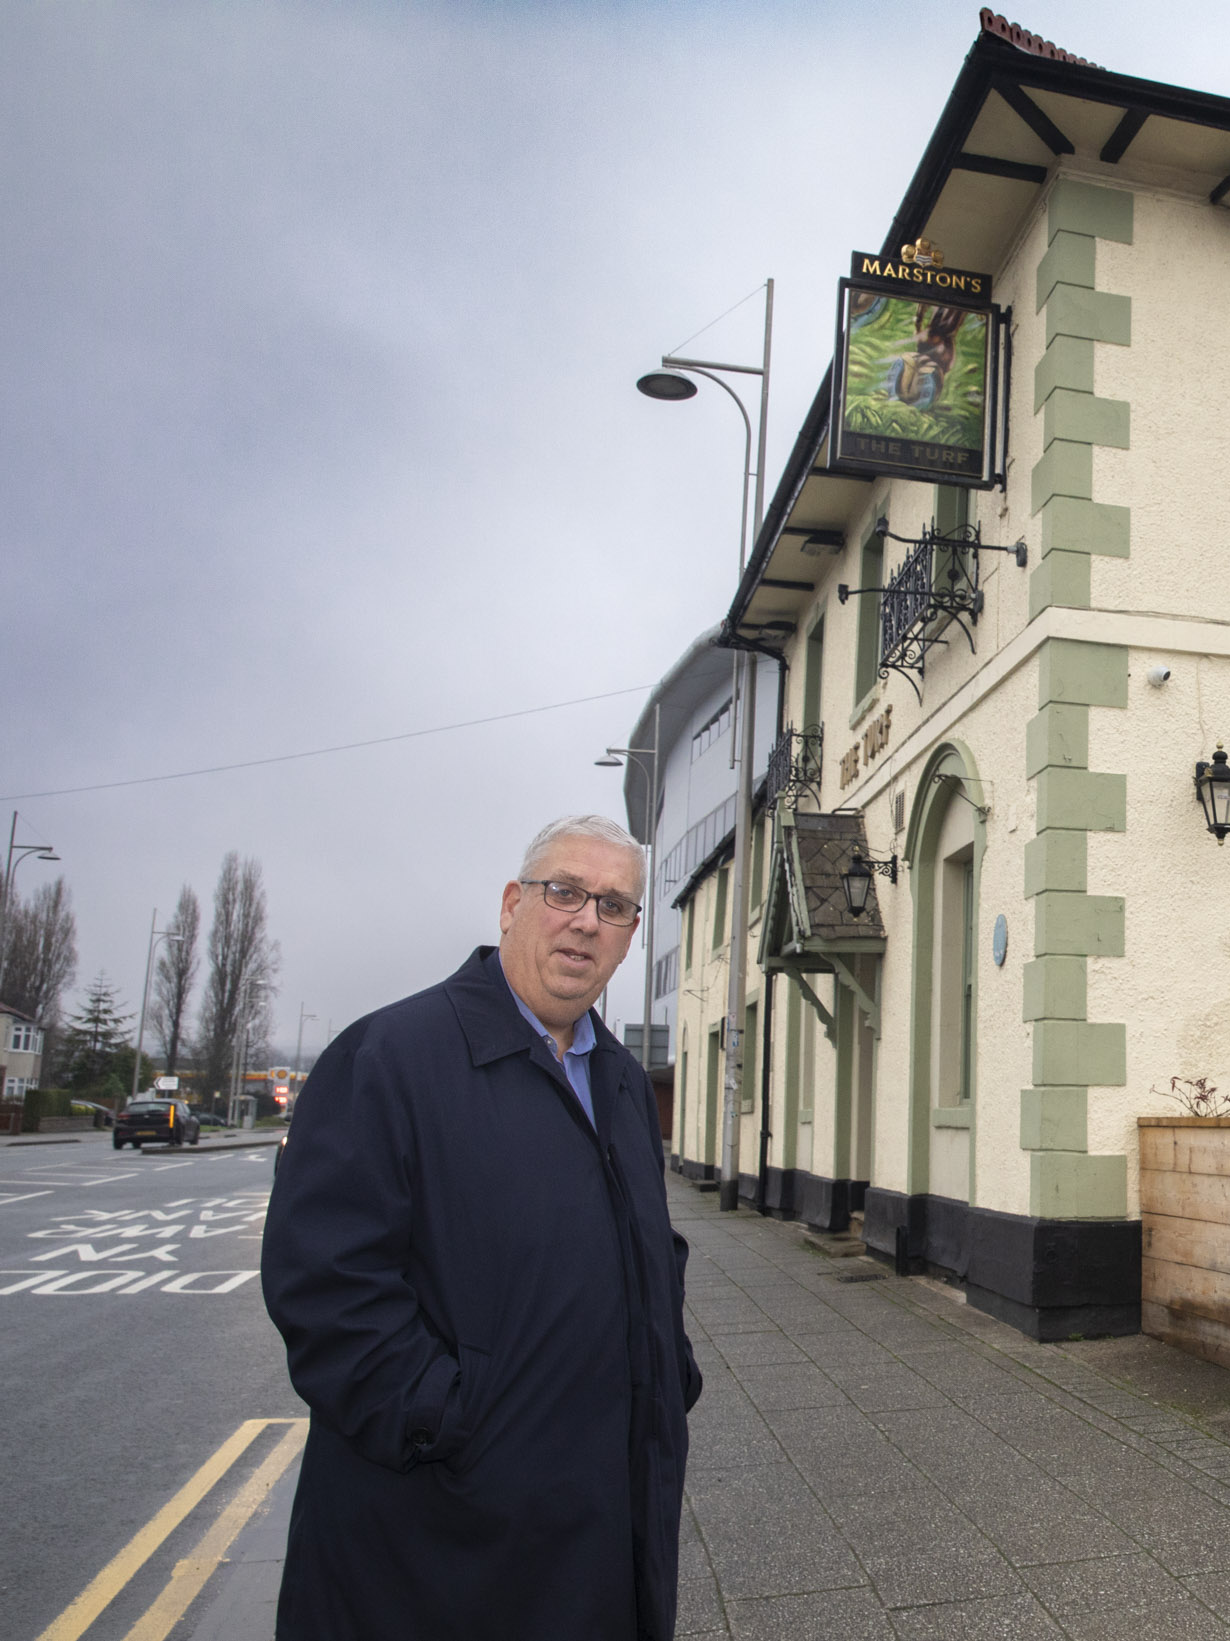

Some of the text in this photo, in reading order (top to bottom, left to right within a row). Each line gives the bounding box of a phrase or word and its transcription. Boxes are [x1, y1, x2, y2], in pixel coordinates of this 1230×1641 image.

[862, 258, 982, 293] MARSTON'S
[857, 438, 971, 464] THE TURF
[839, 704, 893, 790] THE TURF
